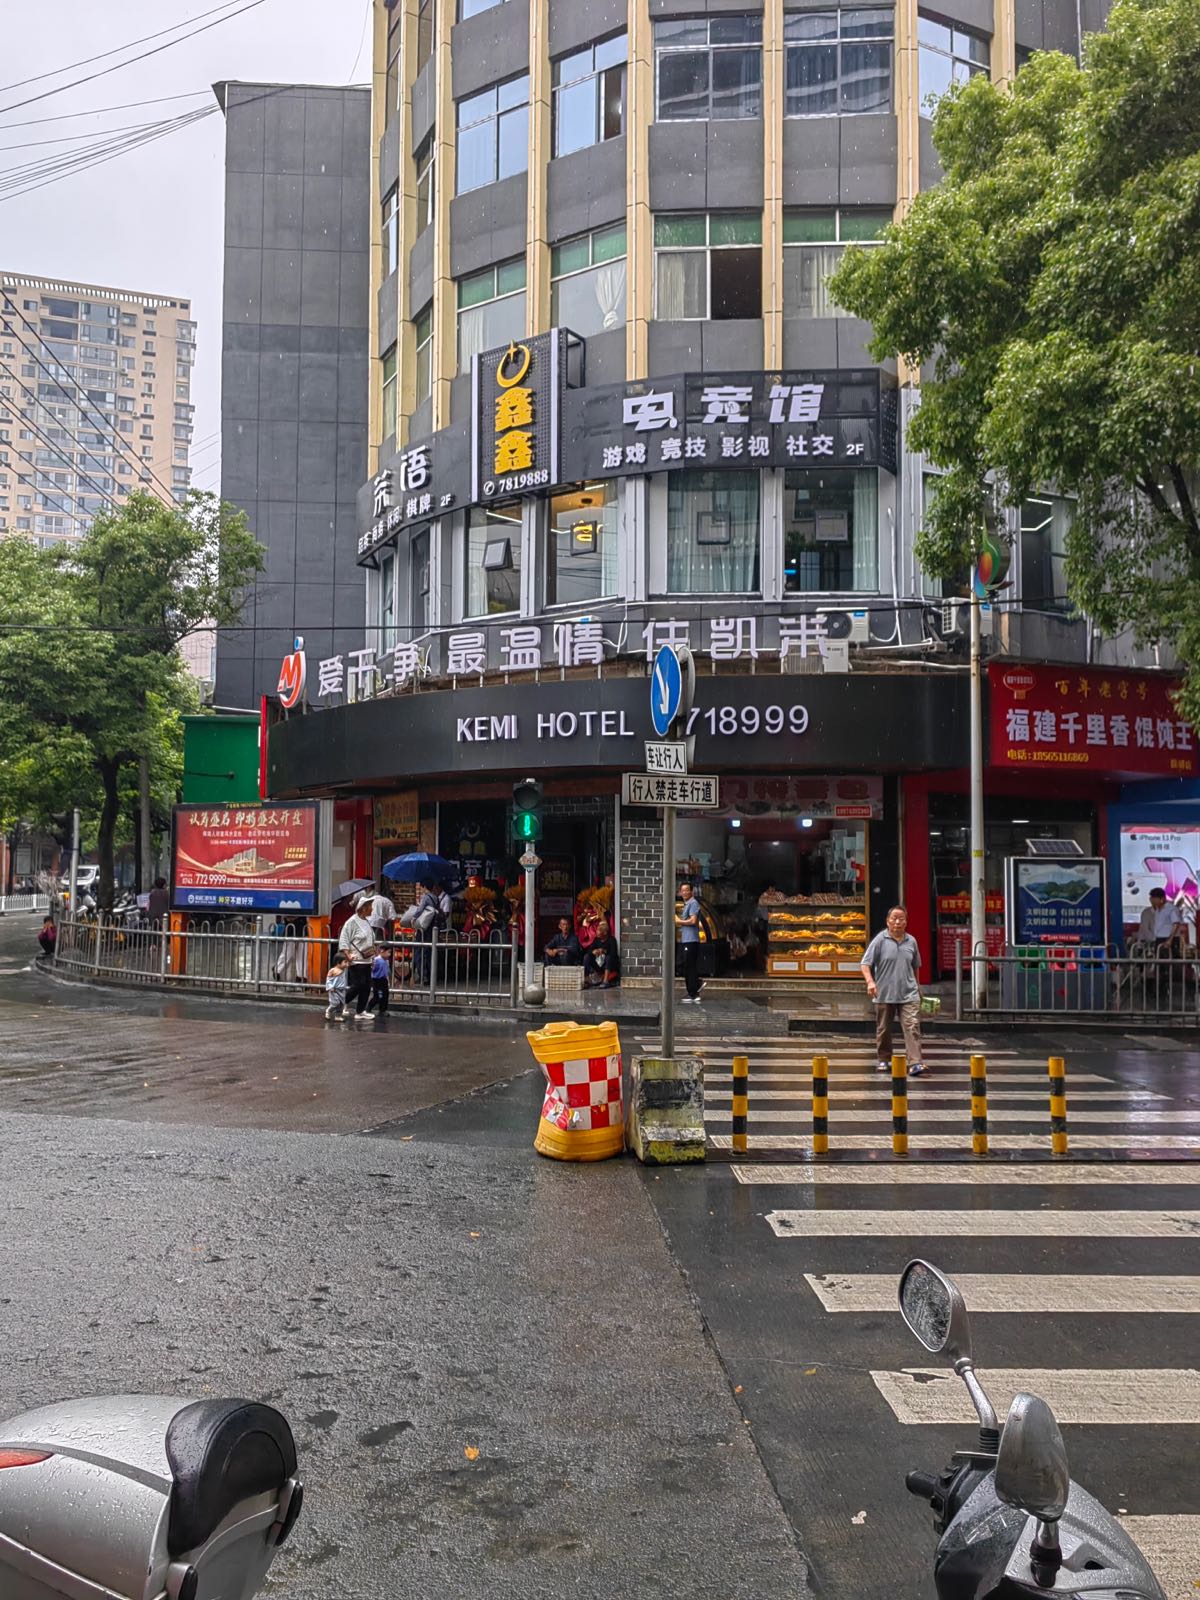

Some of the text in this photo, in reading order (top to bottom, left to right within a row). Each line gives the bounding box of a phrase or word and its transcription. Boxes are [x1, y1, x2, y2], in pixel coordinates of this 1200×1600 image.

[494, 386, 533, 475] 鑫鑫
[602, 434, 865, 470] 游戏 竞技 影视 社交 2F
[499, 469, 549, 493] 7819888
[406, 493, 432, 519] 棋牌
[440, 493, 452, 507] 2F
[457, 714, 518, 742] KEMI
[537, 710, 635, 739] HOTEL
[647, 746, 684, 770] 车让行人
[632, 778, 714, 803] 行人禁走车行道
